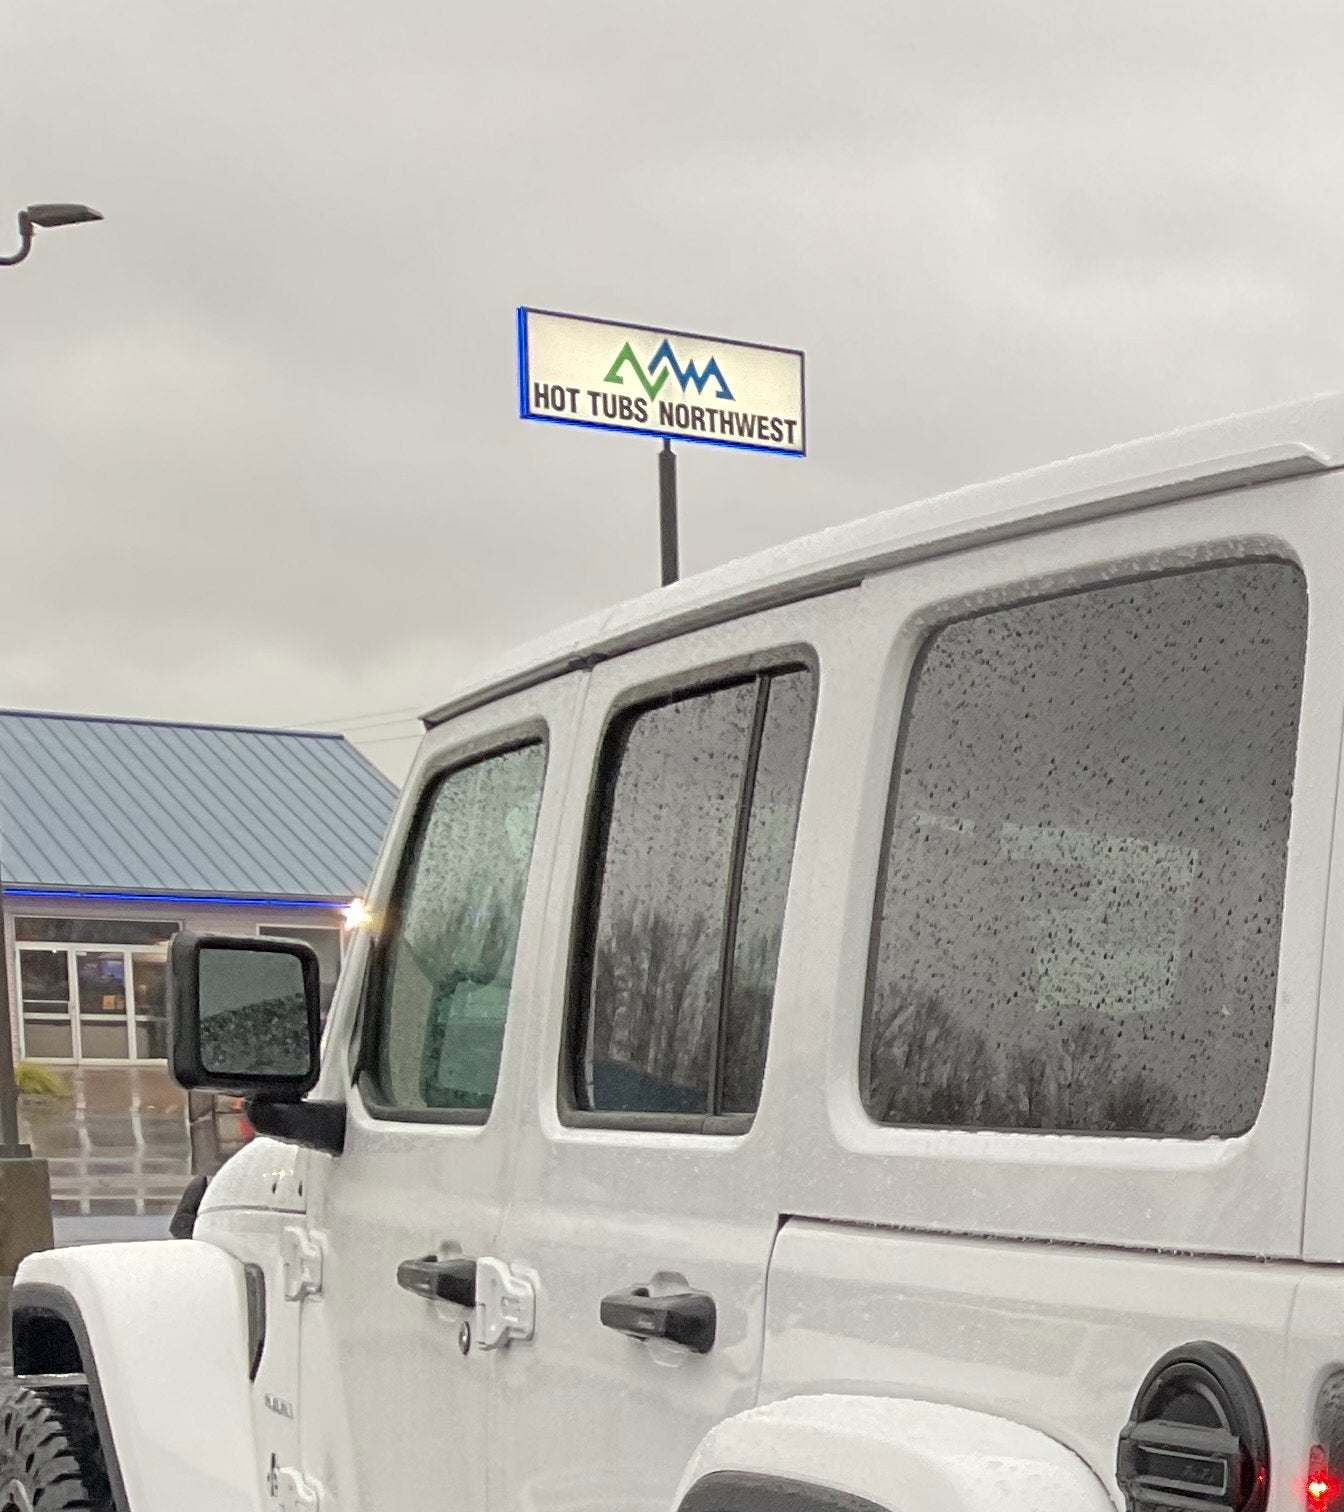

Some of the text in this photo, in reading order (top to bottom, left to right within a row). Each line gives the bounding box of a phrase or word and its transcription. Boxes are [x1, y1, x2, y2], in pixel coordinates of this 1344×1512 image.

[533, 382, 797, 444] HOT TUBS NORTHWEST
